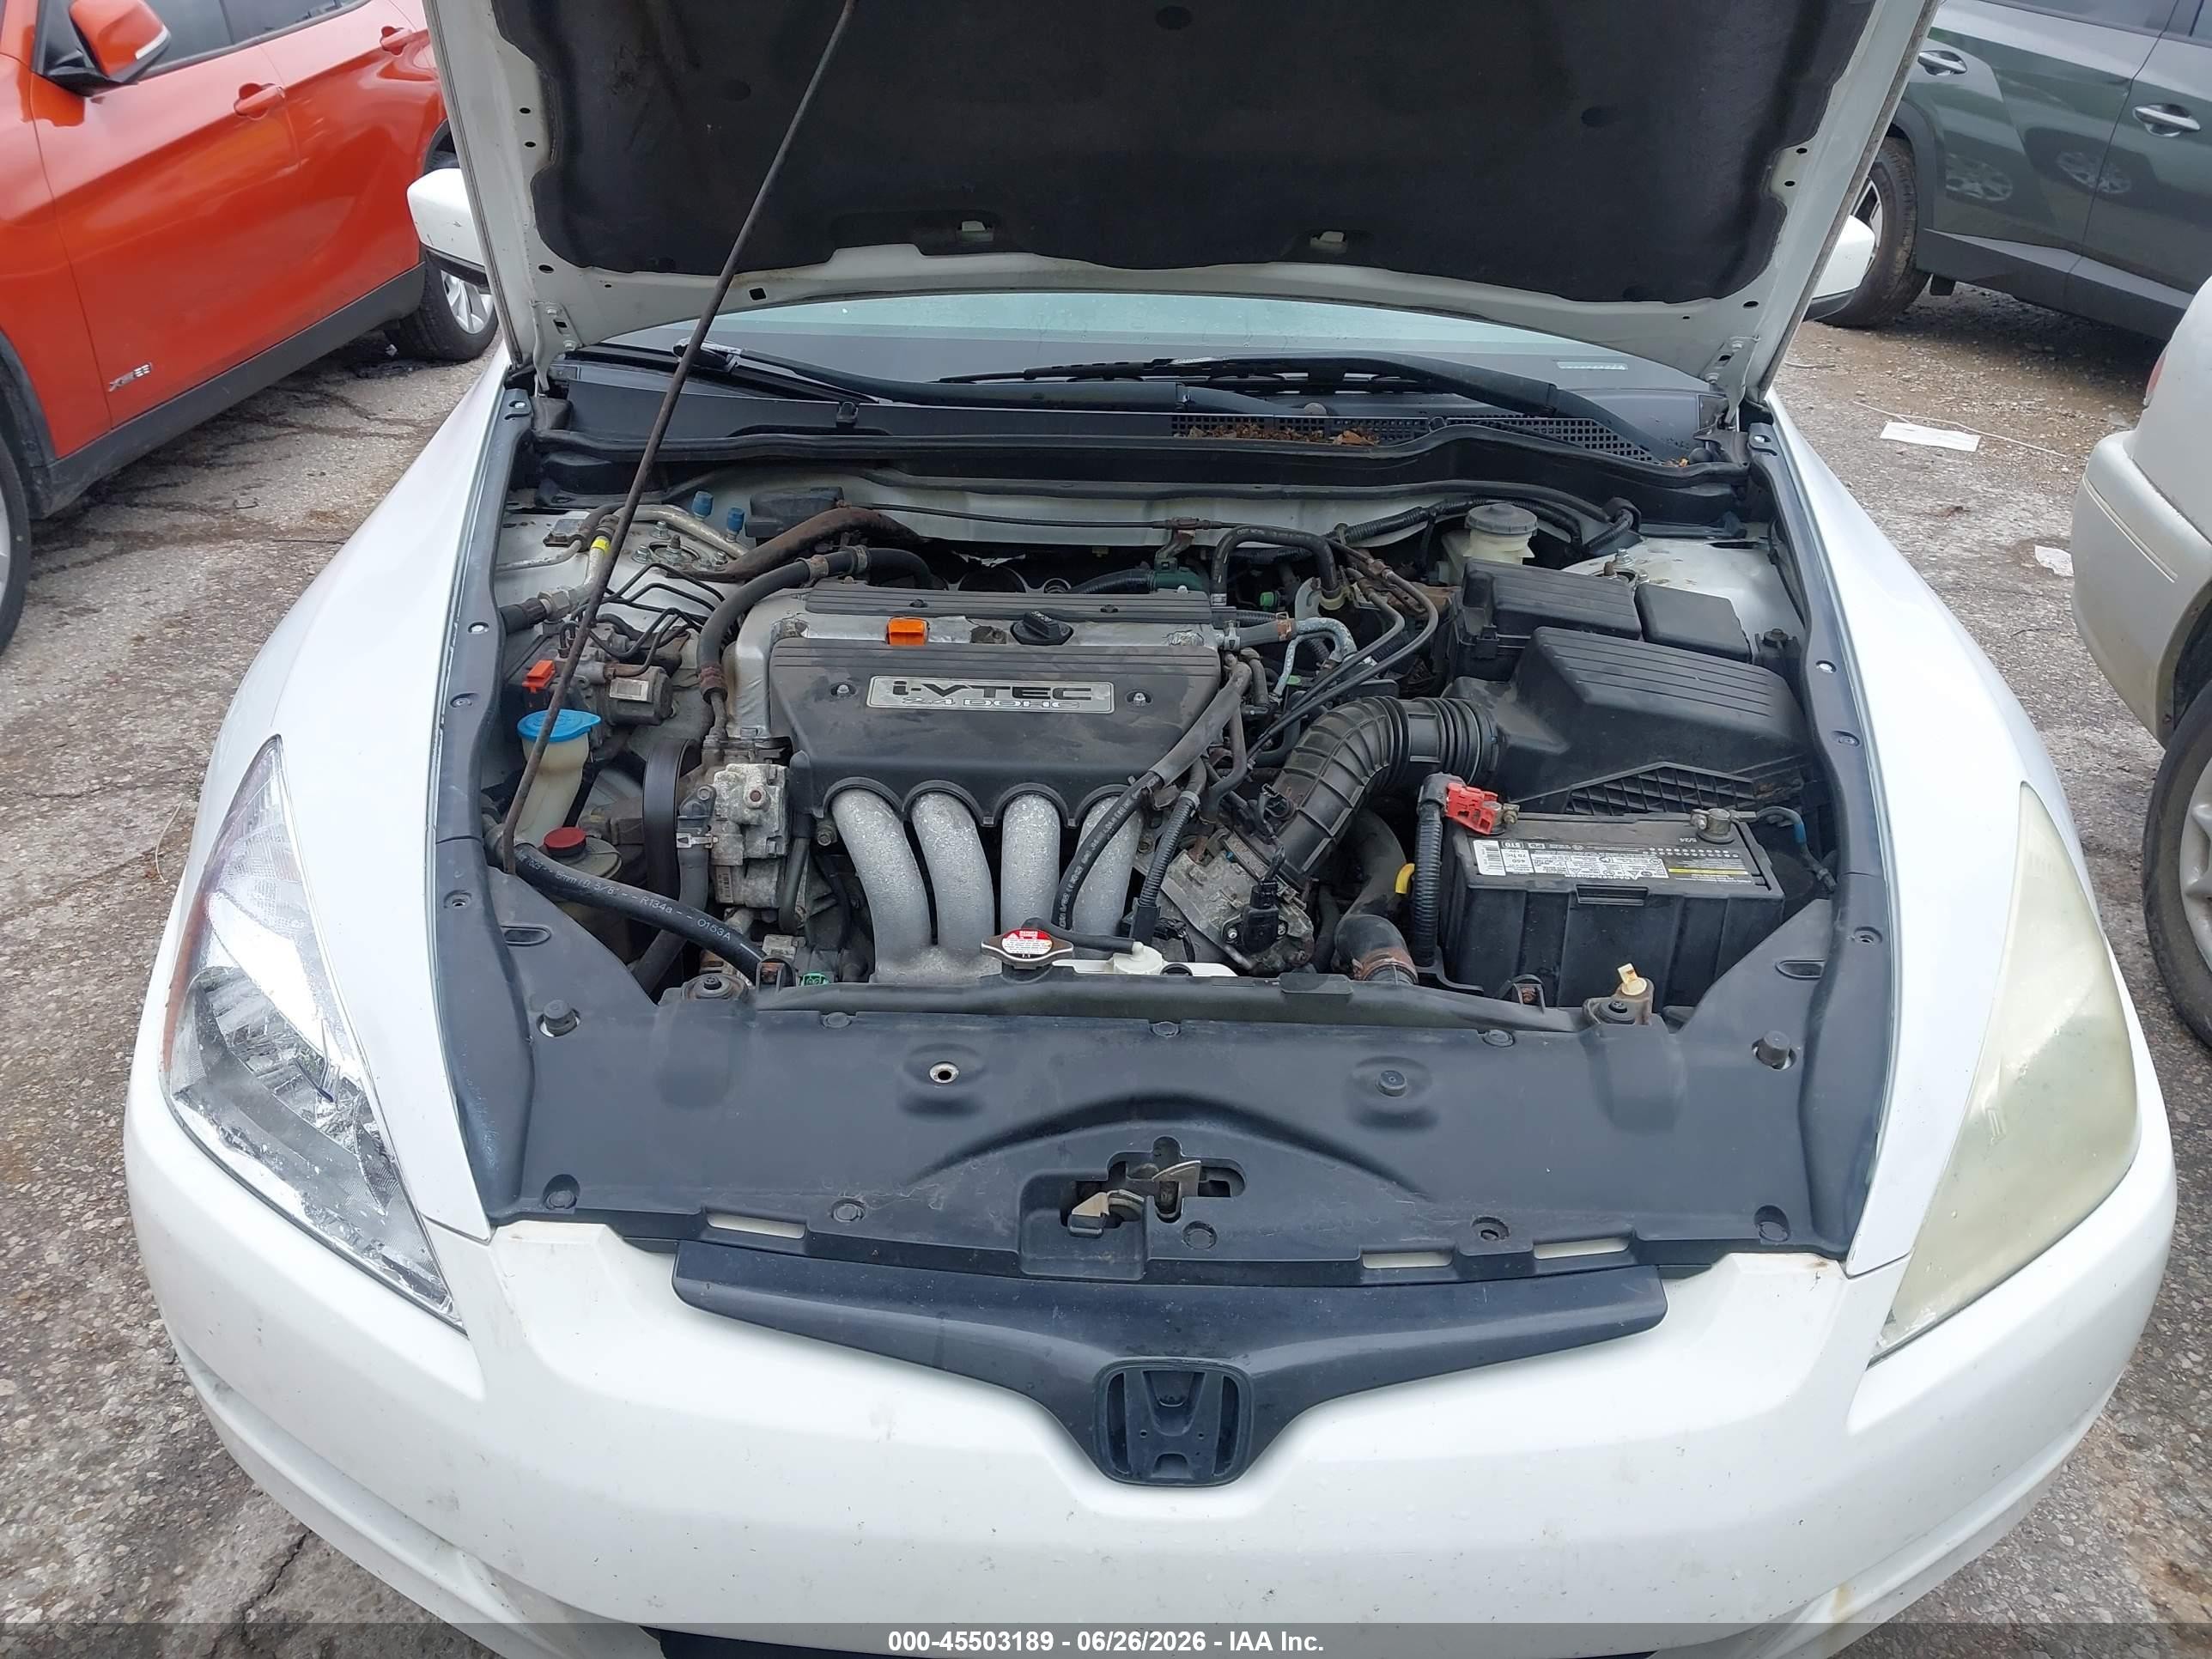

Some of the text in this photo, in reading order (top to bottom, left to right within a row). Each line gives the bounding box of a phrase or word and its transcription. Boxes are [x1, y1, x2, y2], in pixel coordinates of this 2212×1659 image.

[892, 680, 1091, 701] i-VTEC
[902, 696, 1080, 708] 2.4 DOHC
[640, 896, 673, 914] R134a
